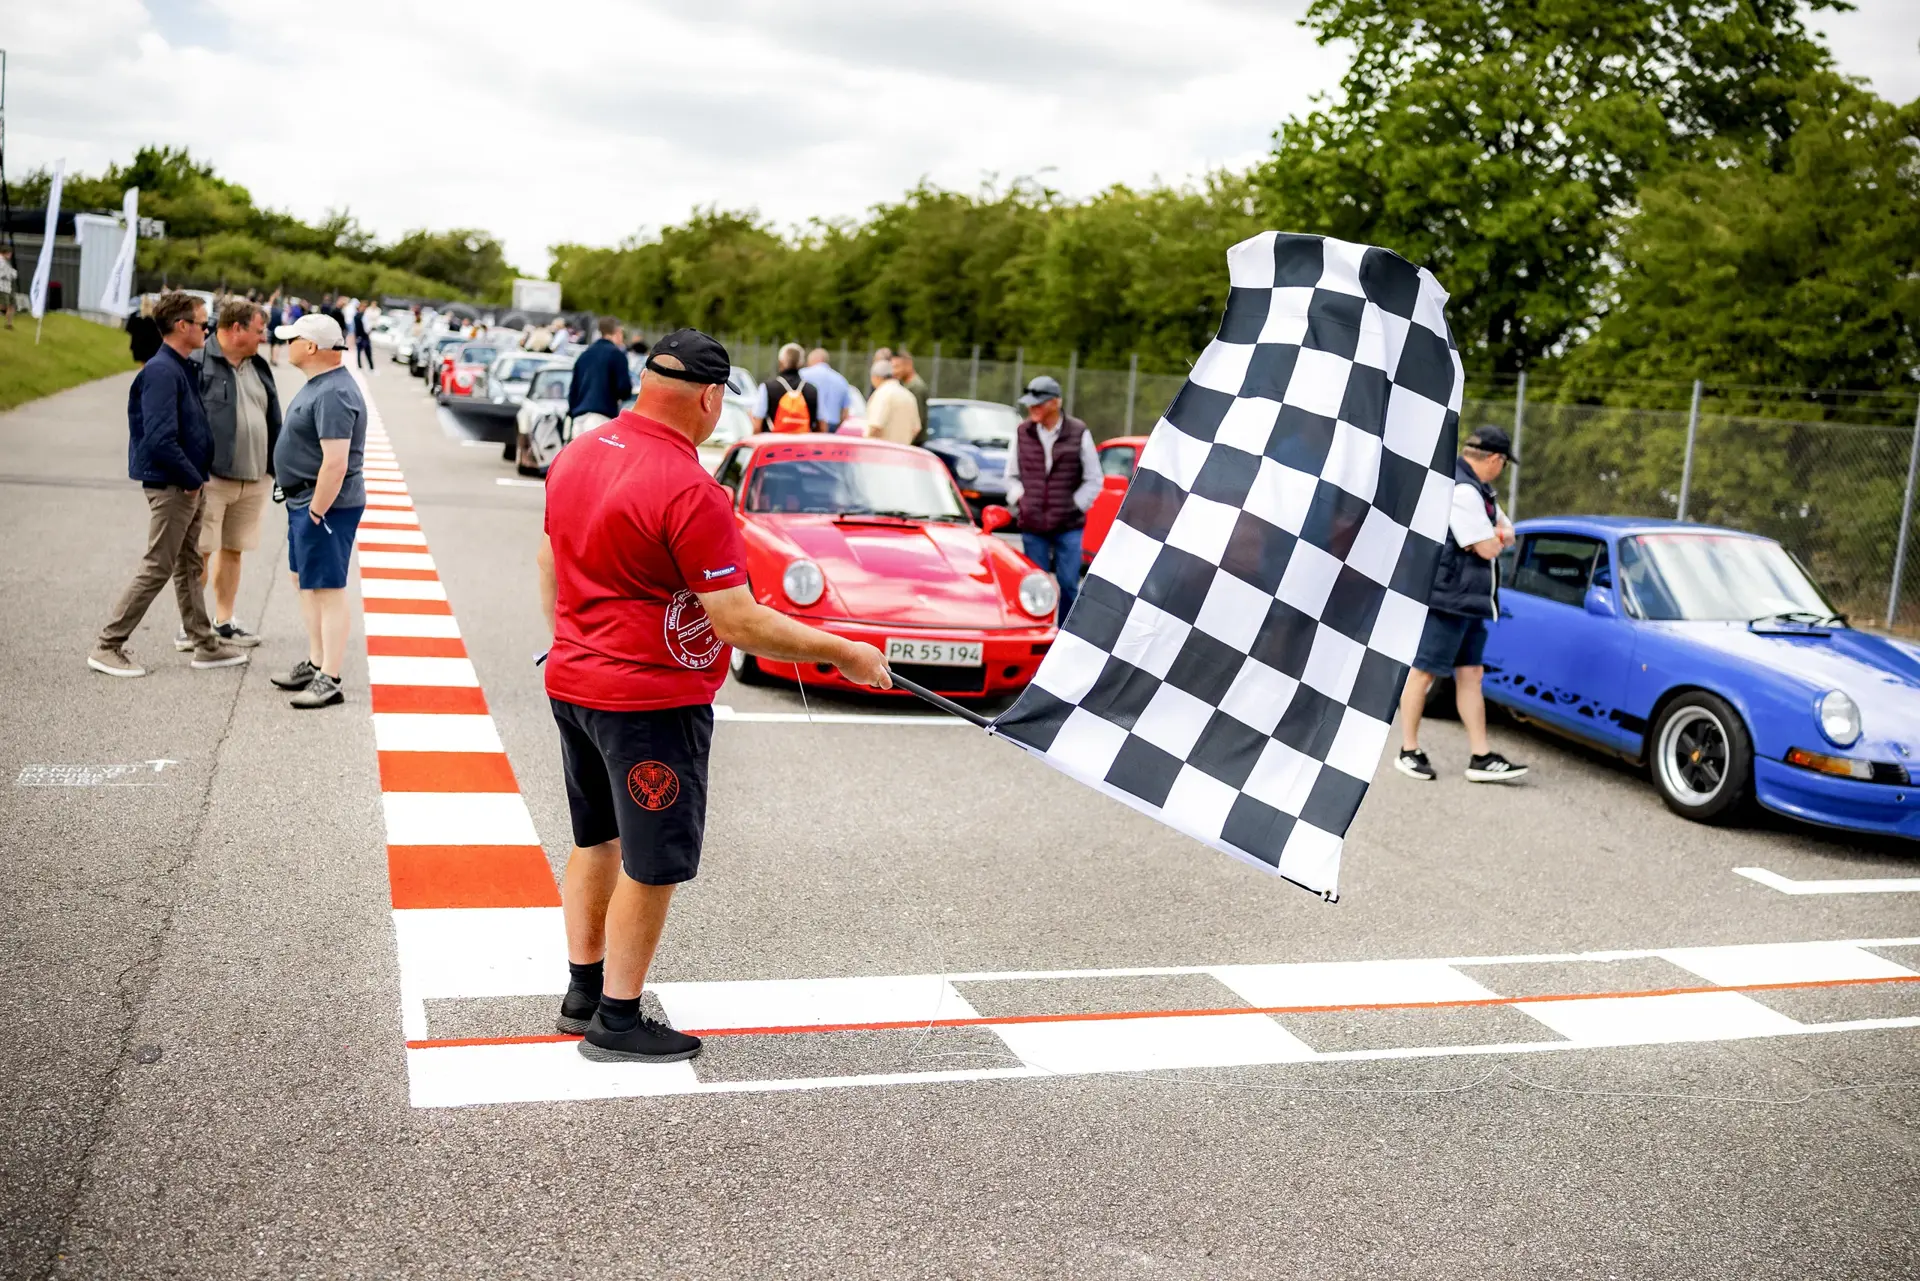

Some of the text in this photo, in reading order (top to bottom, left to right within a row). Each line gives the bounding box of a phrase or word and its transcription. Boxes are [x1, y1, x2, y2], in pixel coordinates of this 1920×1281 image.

[678, 618, 711, 640] PORS
[890, 643, 979, 662] PR 55 194
